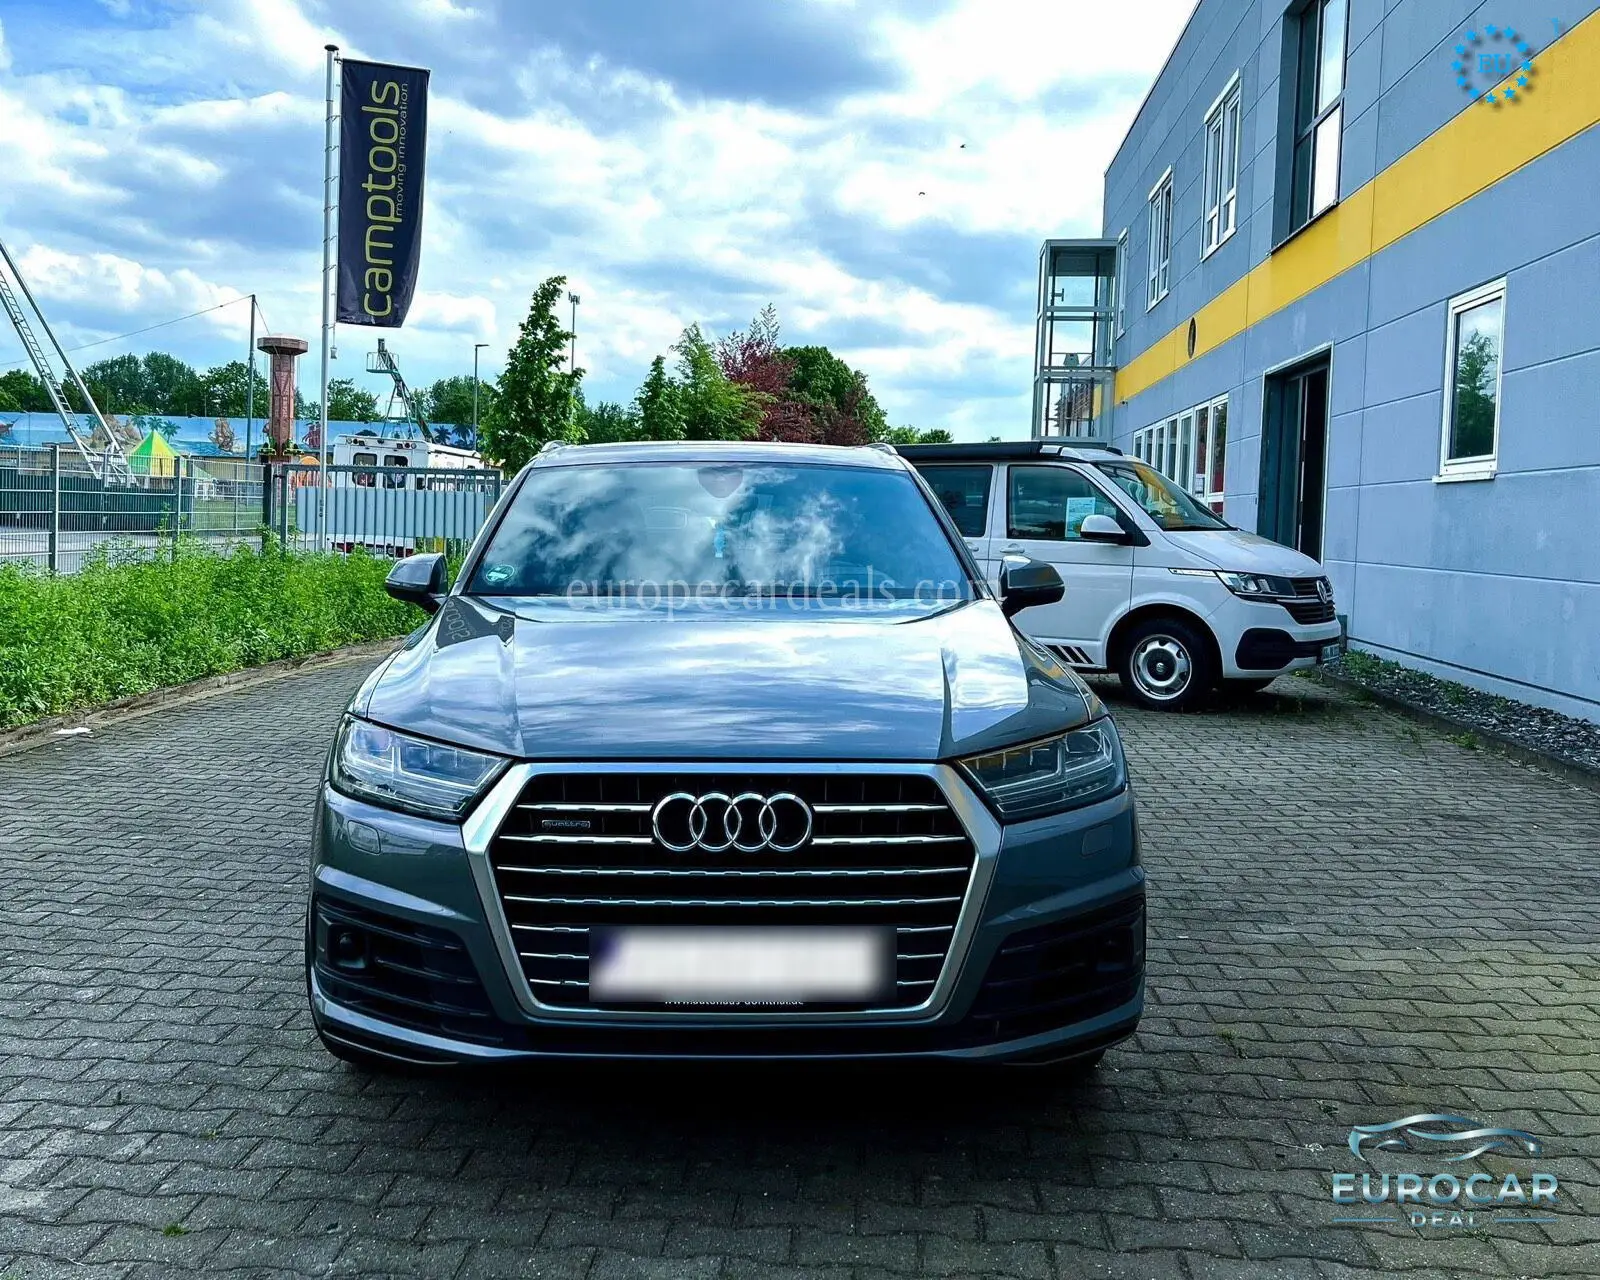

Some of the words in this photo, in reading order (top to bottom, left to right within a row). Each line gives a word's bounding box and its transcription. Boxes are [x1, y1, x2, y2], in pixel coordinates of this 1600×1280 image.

[398, 83, 409, 159] innovation
[361, 80, 403, 317] camptools
[396, 163, 407, 216] moving
[543, 820, 589, 829] quattro
